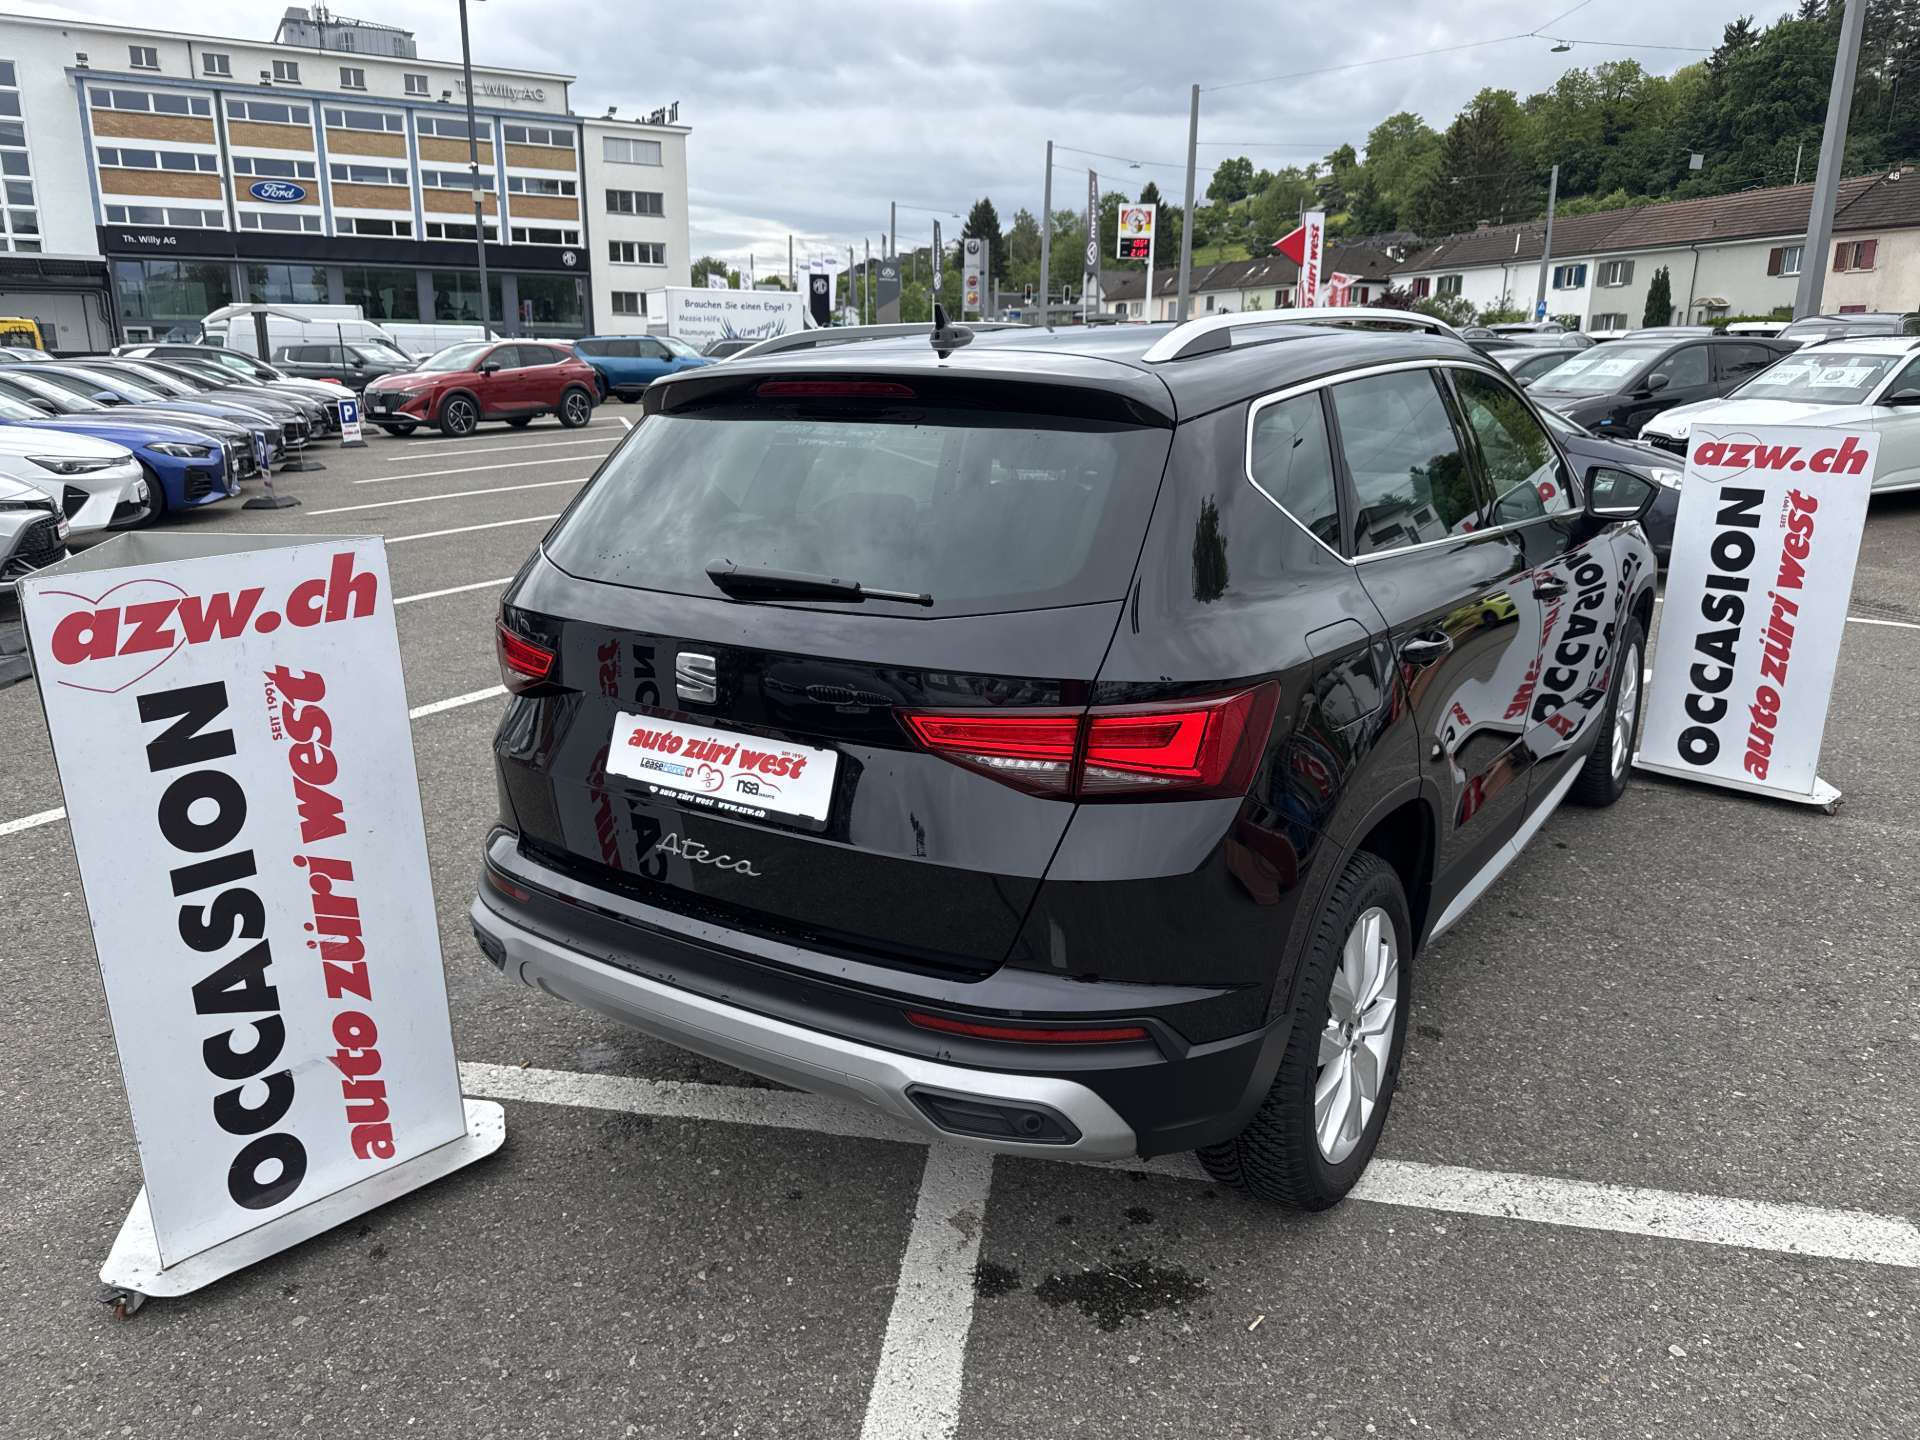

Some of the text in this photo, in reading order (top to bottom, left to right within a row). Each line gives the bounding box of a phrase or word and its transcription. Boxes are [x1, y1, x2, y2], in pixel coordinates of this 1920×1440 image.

[523, 87, 545, 101] AG
[260, 182, 295, 199] Ford
[122, 234, 177, 246] Th. Willy AG
[1309, 223, 1320, 261] west
[812, 278, 828, 295] MG
[684, 299, 722, 310] Brauchen
[724, 301, 738, 310] Sie
[740, 302, 761, 311] einen
[763, 301, 785, 313] Engel
[703, 315, 721, 323] Hilfe
[343, 405, 354, 421] P
[1693, 437, 1869, 475] azw.ch
[1780, 514, 1788, 529] SEIT
[51, 551, 378, 666] azw.ch
[1677, 486, 1766, 766] OCCASION
[1743, 488, 1819, 781] auto züri west
[263, 681, 283, 741] SEIT 1991
[628, 727, 807, 780] auto züri west
[659, 787, 766, 819] auto züri west www.azw.ch
[736, 779, 760, 796] nsa
[656, 832, 762, 877] Ateca
[263, 664, 395, 1161] auto züri west
[136, 680, 307, 1210] OCCASION
